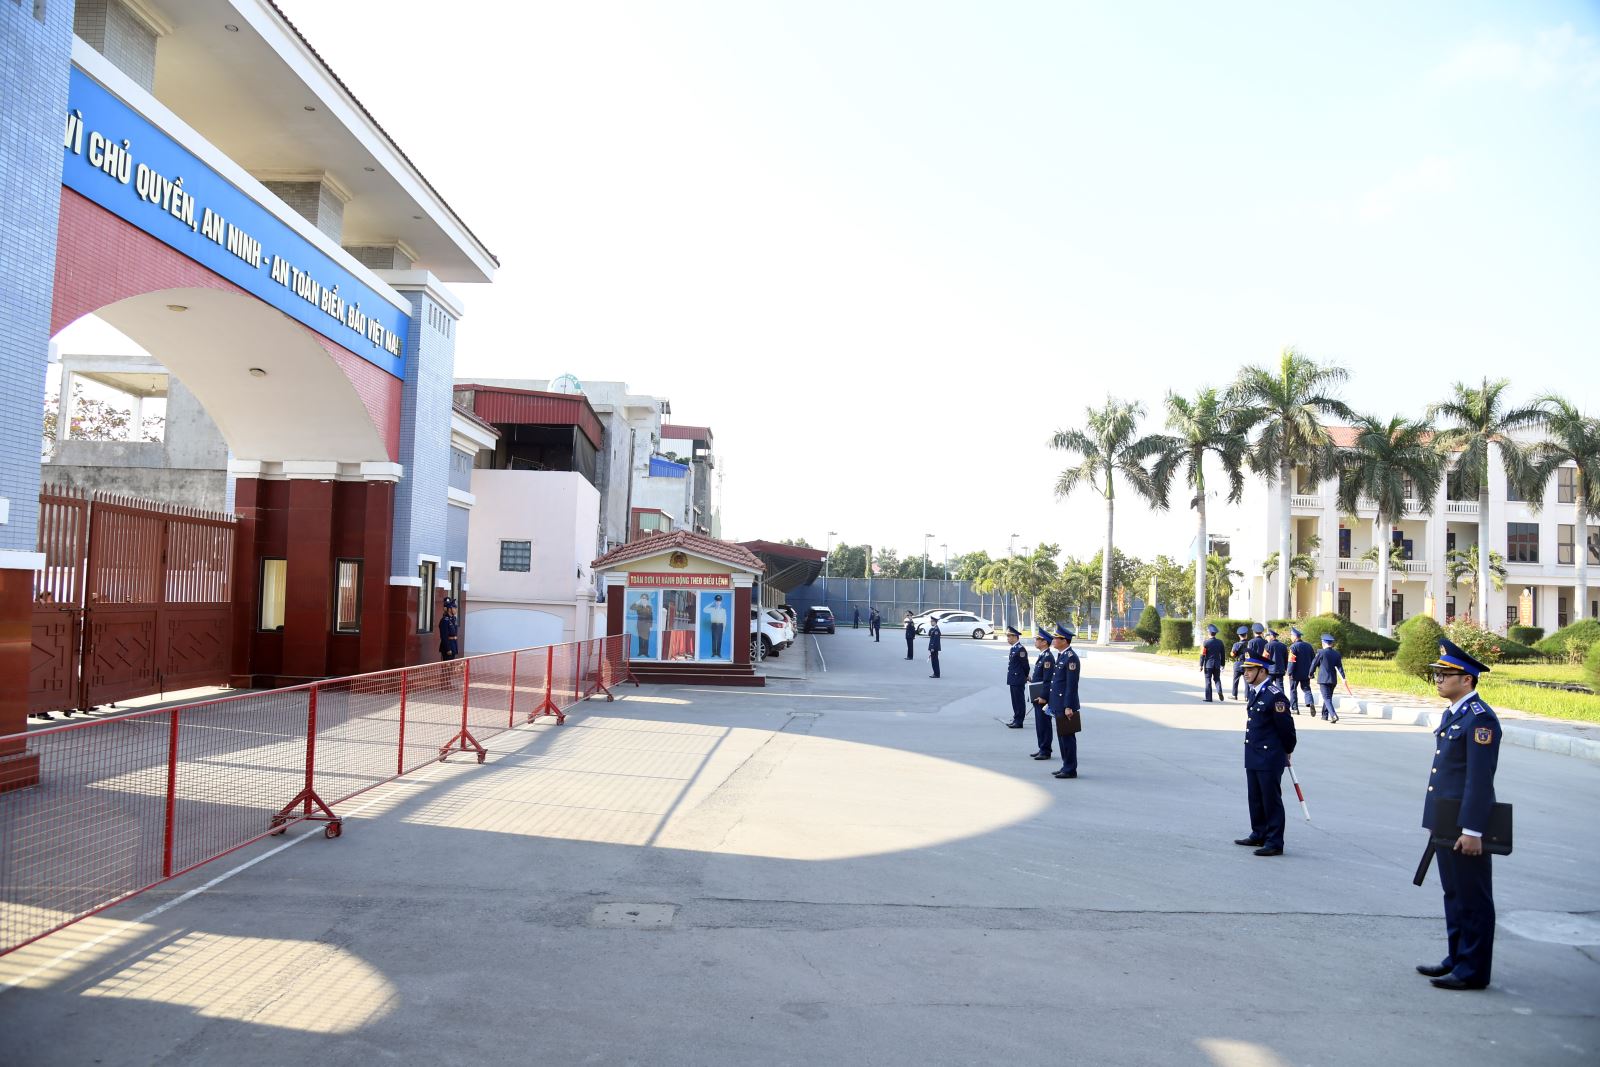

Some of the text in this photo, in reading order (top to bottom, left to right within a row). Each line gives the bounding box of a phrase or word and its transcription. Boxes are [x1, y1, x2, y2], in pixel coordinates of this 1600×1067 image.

[88, 131, 132, 184] CHỦ
[136, 163, 198, 232] QUYỀN,
[201, 207, 224, 245] AN
[227, 223, 262, 269] NINH
[271, 255, 289, 287] AN
[292, 266, 319, 305] TOÀN
[320, 284, 346, 326] BIỂN,
[347, 302, 365, 335] ĐẢO
[367, 317, 385, 348] VIỆT
[690, 576, 702, 585] THEO
